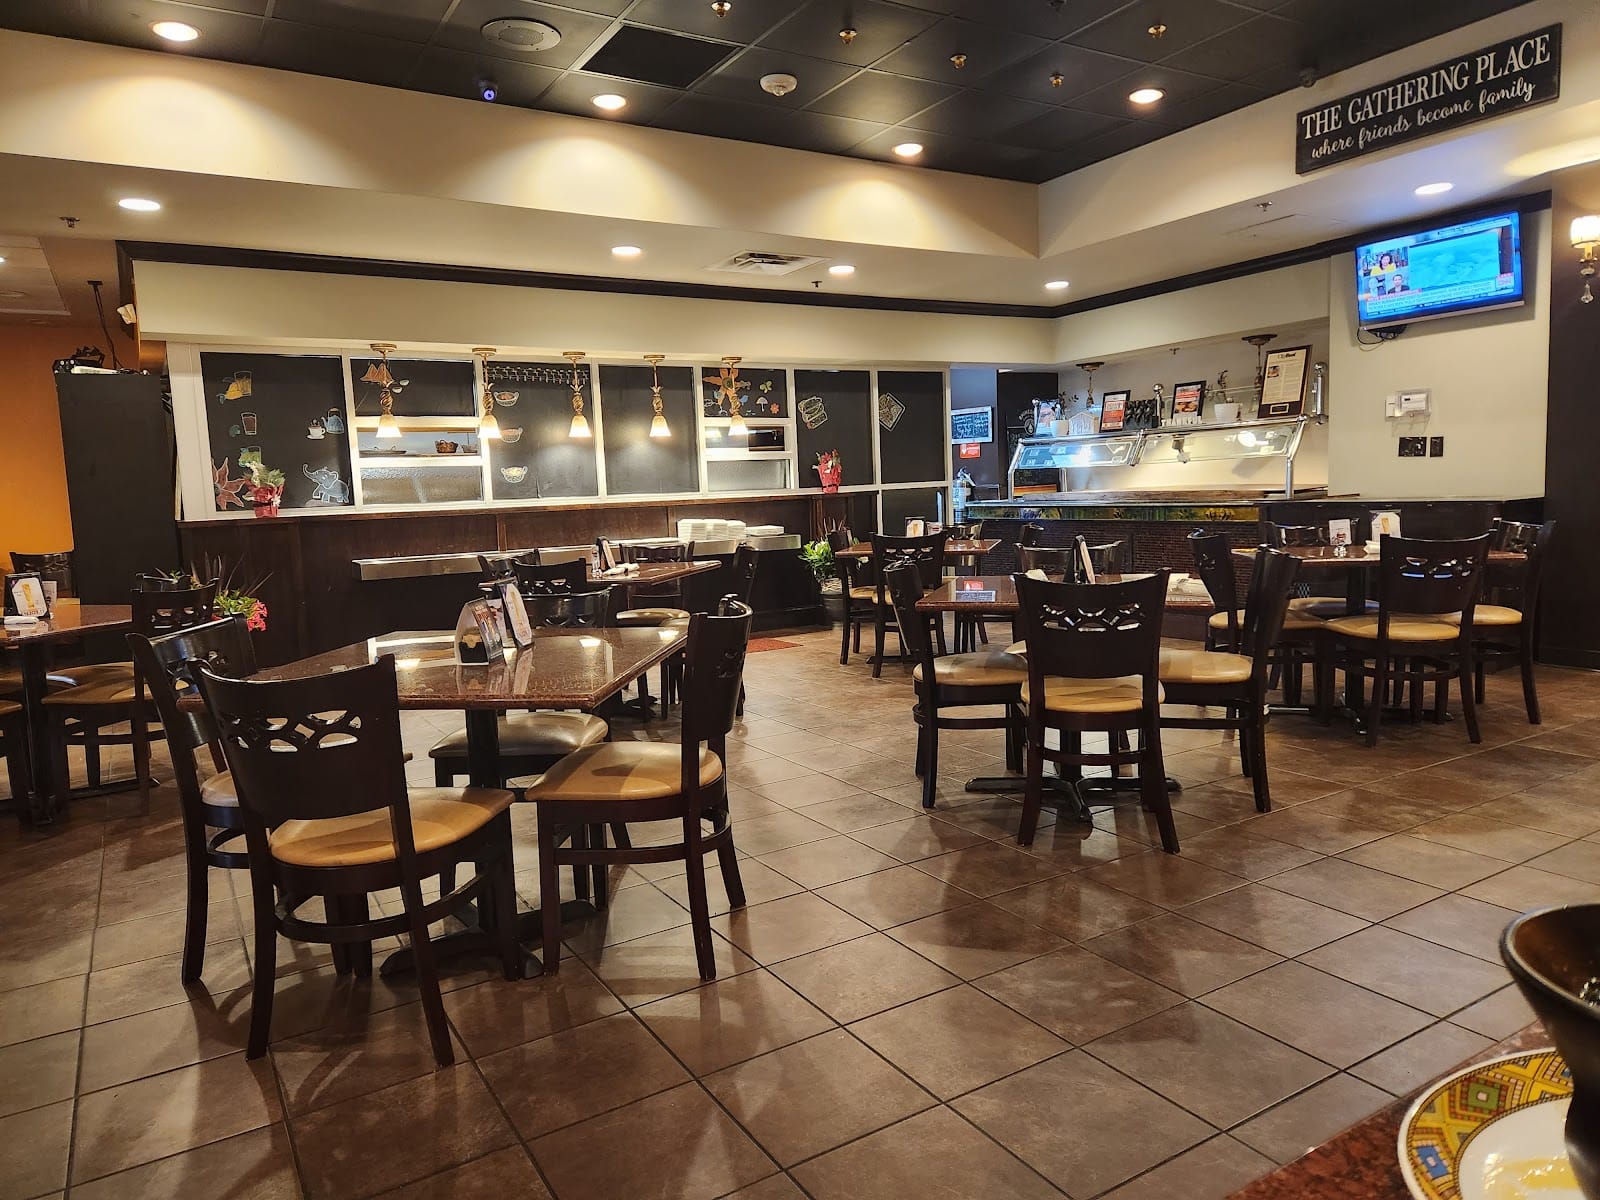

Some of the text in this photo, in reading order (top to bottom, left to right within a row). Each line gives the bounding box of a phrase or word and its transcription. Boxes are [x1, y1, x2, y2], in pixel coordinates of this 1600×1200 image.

[1301, 33, 1551, 140] THE GATHERING PLACE
[1311, 77, 1536, 159] where friends become family
